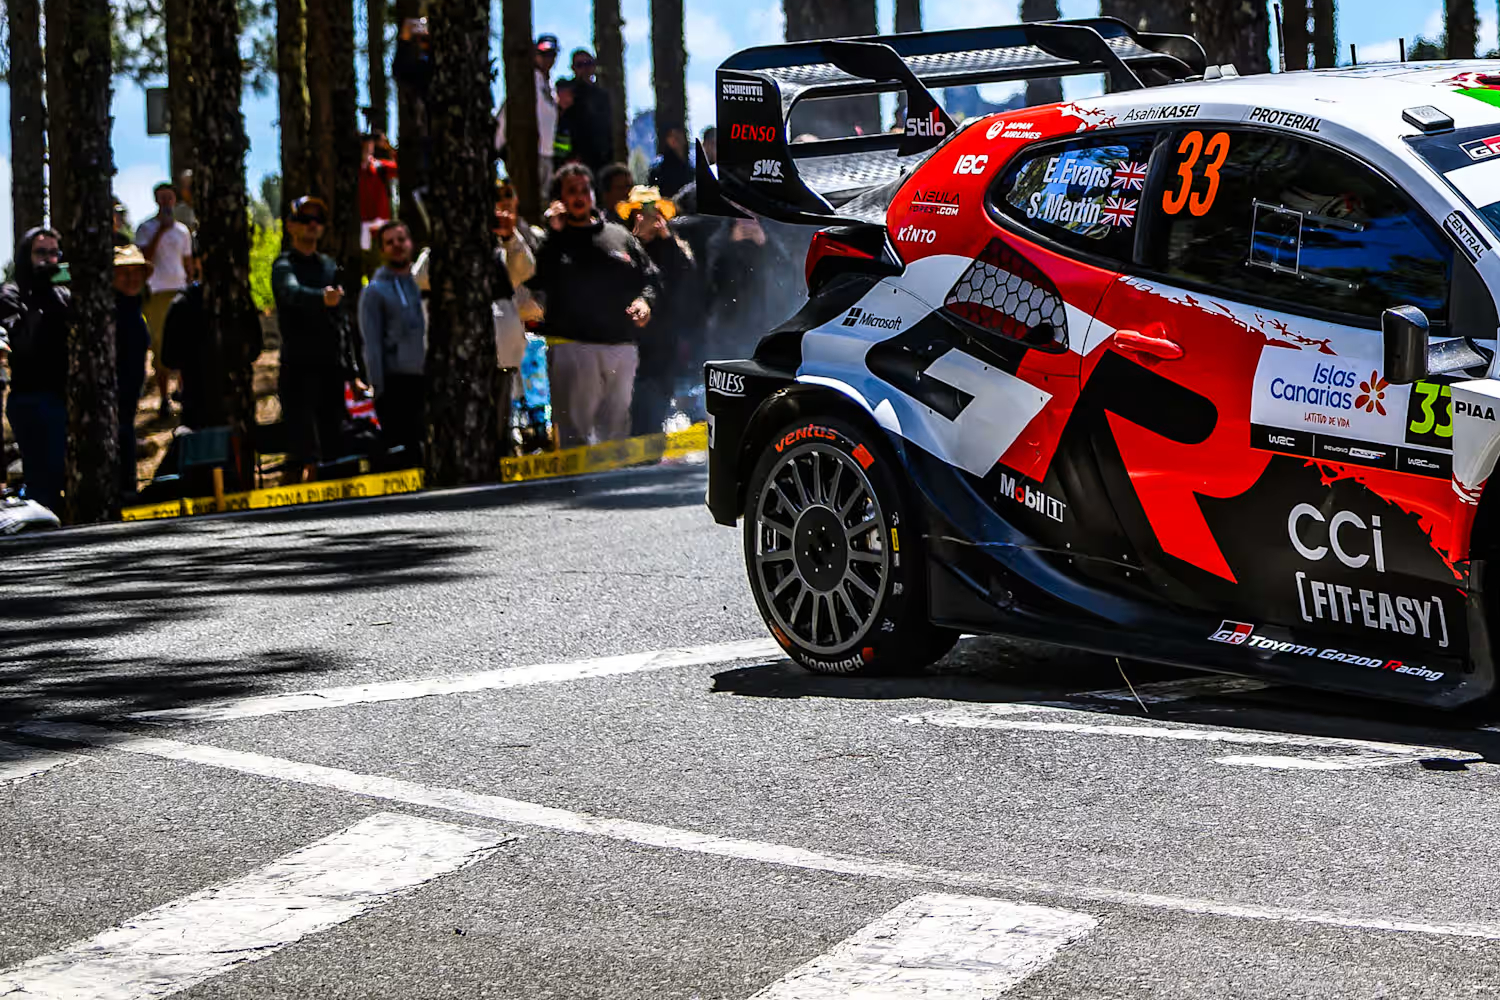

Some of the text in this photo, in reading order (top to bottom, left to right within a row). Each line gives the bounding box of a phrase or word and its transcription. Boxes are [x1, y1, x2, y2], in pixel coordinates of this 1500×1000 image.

[730, 123, 776, 142] DENSO
[906, 111, 946, 136] Stilo
[1005, 122, 1034, 130] JAPAN
[1250, 107, 1321, 133] PROTERIAL
[1001, 132, 1042, 140] AIRLINES
[753, 159, 783, 177] SWS
[1043, 157, 1112, 188] E.Evans
[1162, 130, 1230, 217] 33
[1027, 191, 1101, 224] S.Martin
[1447, 212, 1485, 259] CENTRAL
[858, 312, 903, 331] Microsoft
[708, 368, 746, 394] ENDLESS
[1312, 363, 1357, 388] Islas
[1270, 377, 1352, 410] Canarias
[1304, 411, 1351, 428] LATITUD DE VIDA
[1455, 400, 1497, 422] PIAA
[1268, 433, 1296, 447] WRC
[264, 488, 304, 507] ZONA
[383, 472, 421, 495] ZONA
[999, 472, 1045, 514] Mobil
[1213, 630, 1444, 682] GR TOYOTA GAZOO Racing
